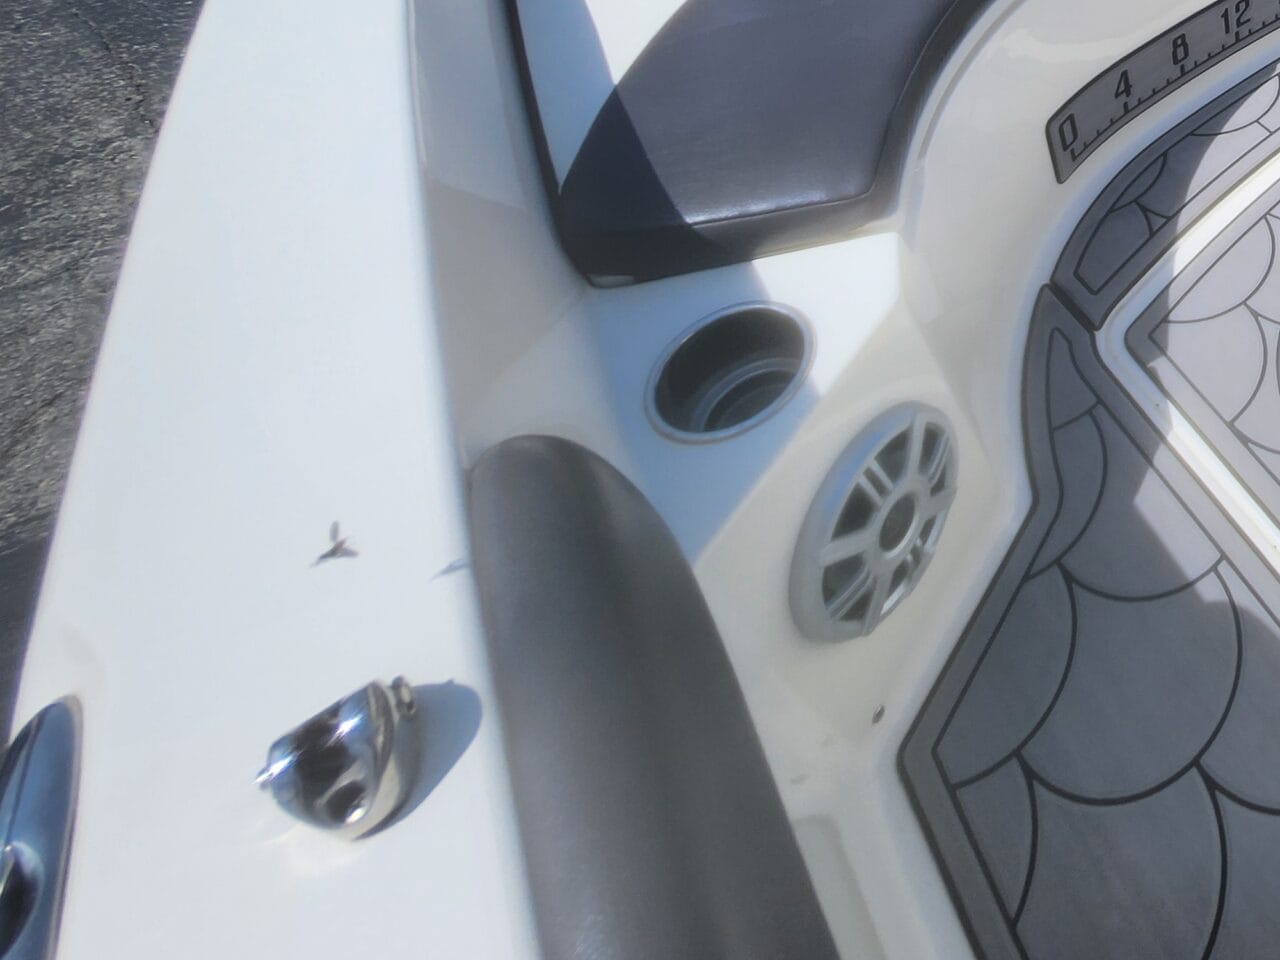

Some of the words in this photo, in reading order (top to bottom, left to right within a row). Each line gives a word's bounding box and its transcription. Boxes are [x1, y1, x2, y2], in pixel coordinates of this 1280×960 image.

[1058, 113, 1078, 152] 0
[1115, 69, 1133, 100] 4
[1172, 32, 1190, 66] 8
